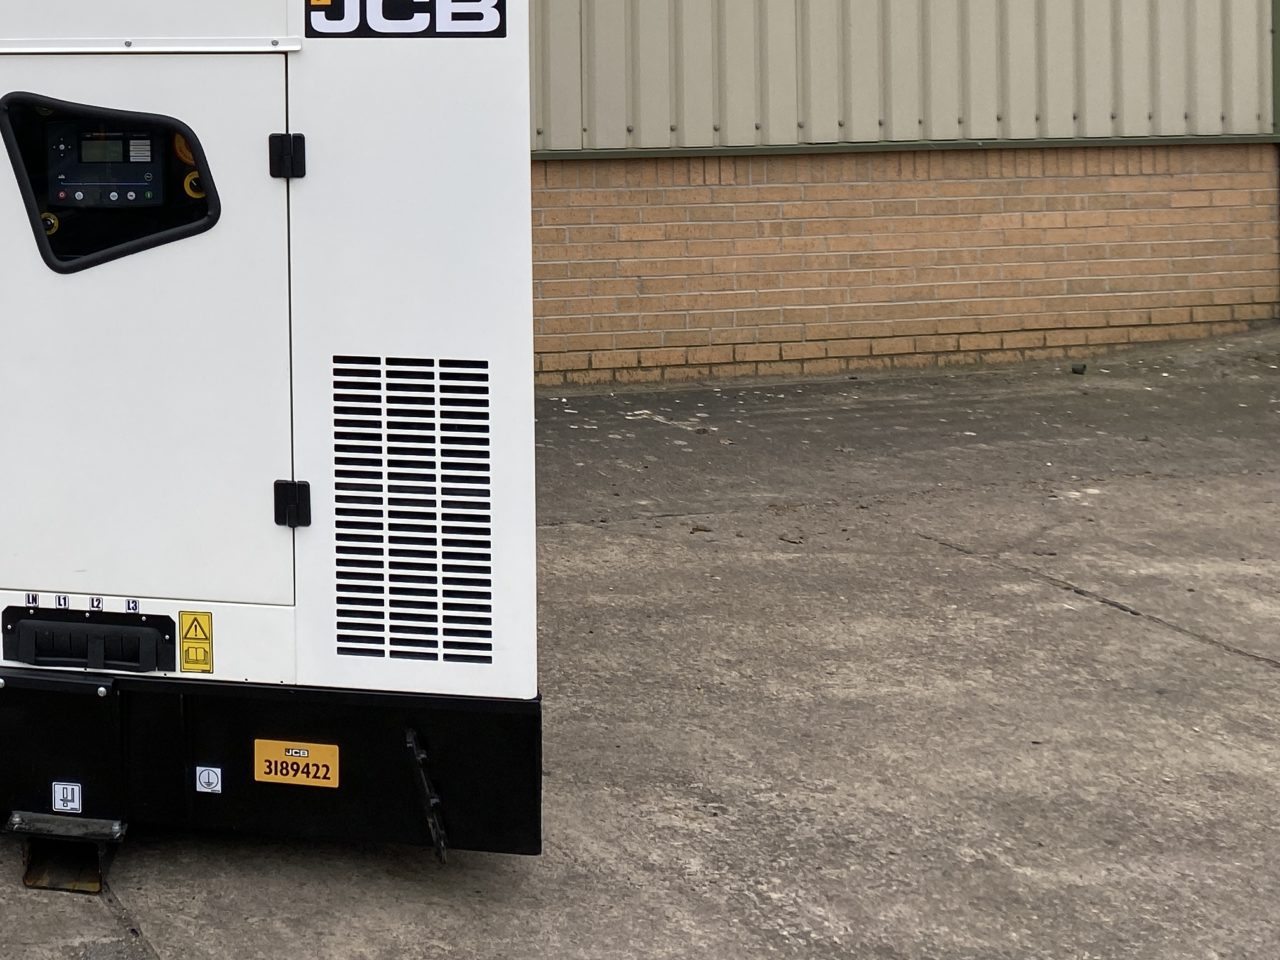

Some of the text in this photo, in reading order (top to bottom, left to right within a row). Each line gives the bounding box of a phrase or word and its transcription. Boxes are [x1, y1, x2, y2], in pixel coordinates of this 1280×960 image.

[27, 593, 38, 605] LN
[57, 595, 67, 607] L1
[91, 597, 102, 609] L2
[127, 599, 138, 611] L3
[285, 748, 309, 757] JCB
[263, 759, 331, 781] 3189422
